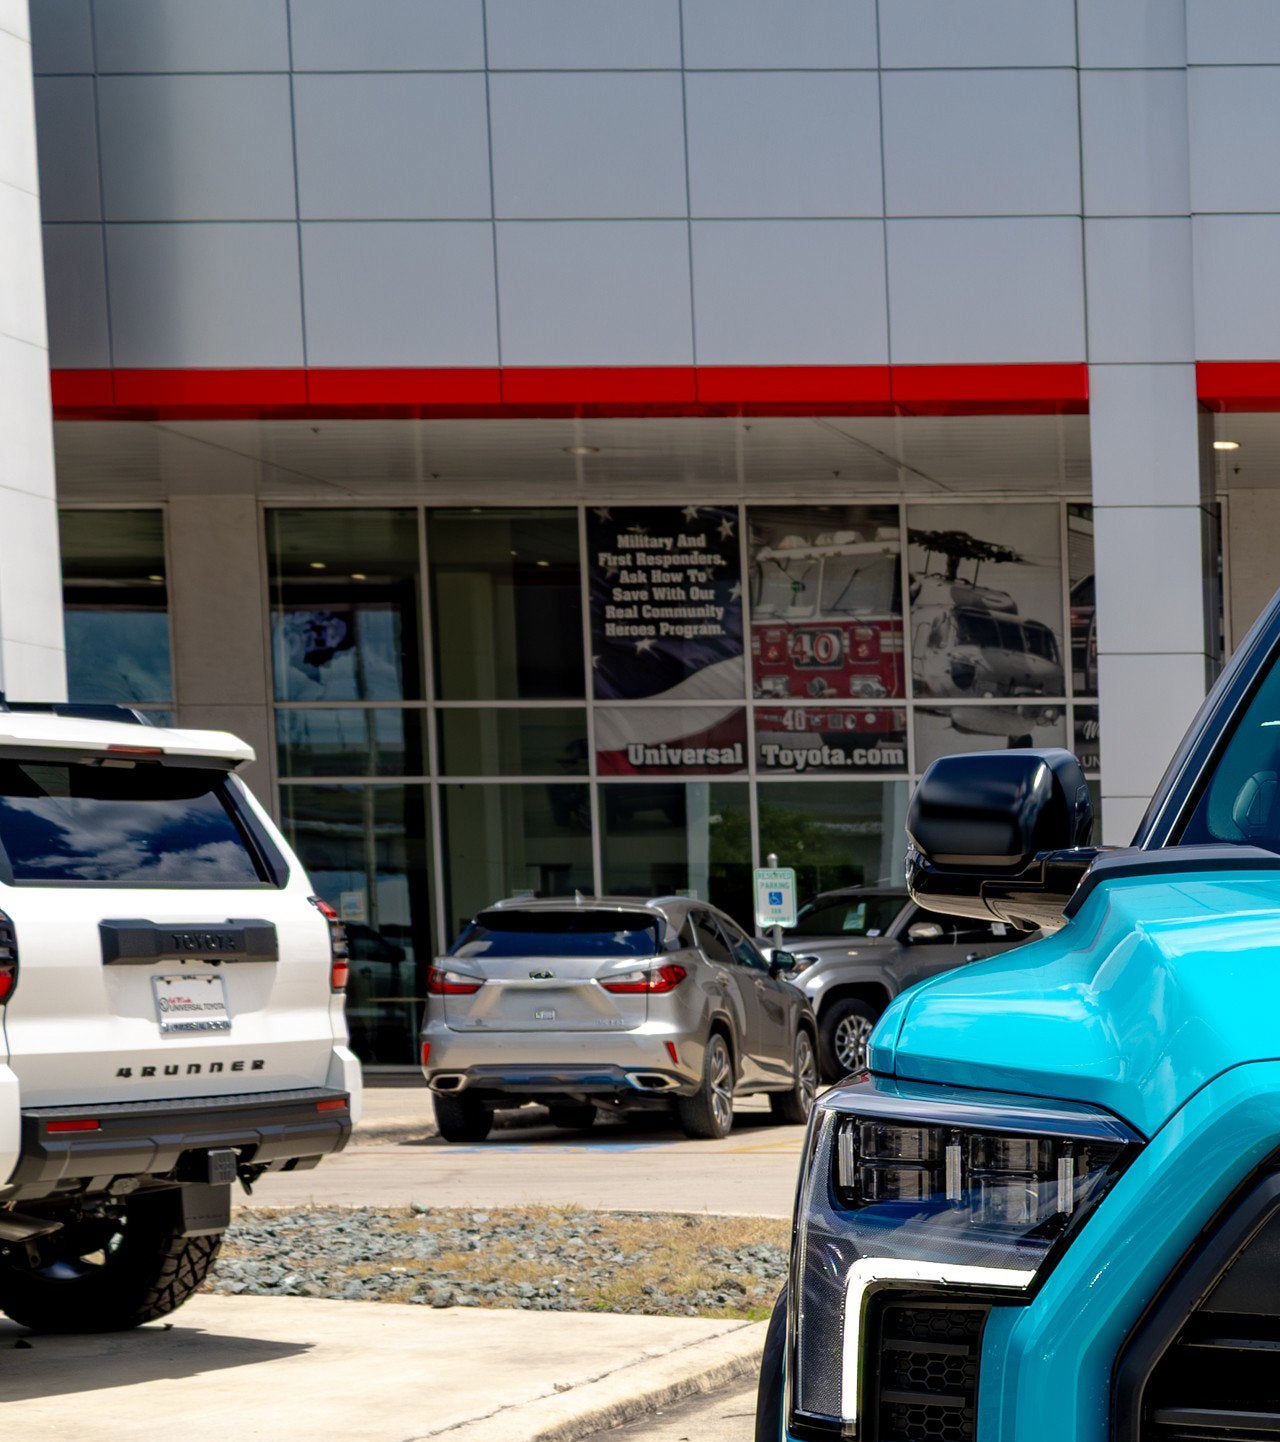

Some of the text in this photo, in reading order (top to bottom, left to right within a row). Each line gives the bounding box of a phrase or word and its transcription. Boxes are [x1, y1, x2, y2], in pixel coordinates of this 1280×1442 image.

[617, 533, 706, 550] Military And
[598, 552, 633, 566] First
[619, 568, 707, 584] Ask How To
[612, 586, 715, 602] Save With Our
[605, 604, 725, 620] Real Community
[605, 622, 726, 639] Heroes Program.
[790, 631, 841, 664] 40
[783, 709, 806, 731] 40
[627, 743, 905, 771] Universal Toyota.com
[172, 934, 236, 950] TOYOTA
[115, 1059, 265, 1078] 4RUNNER
